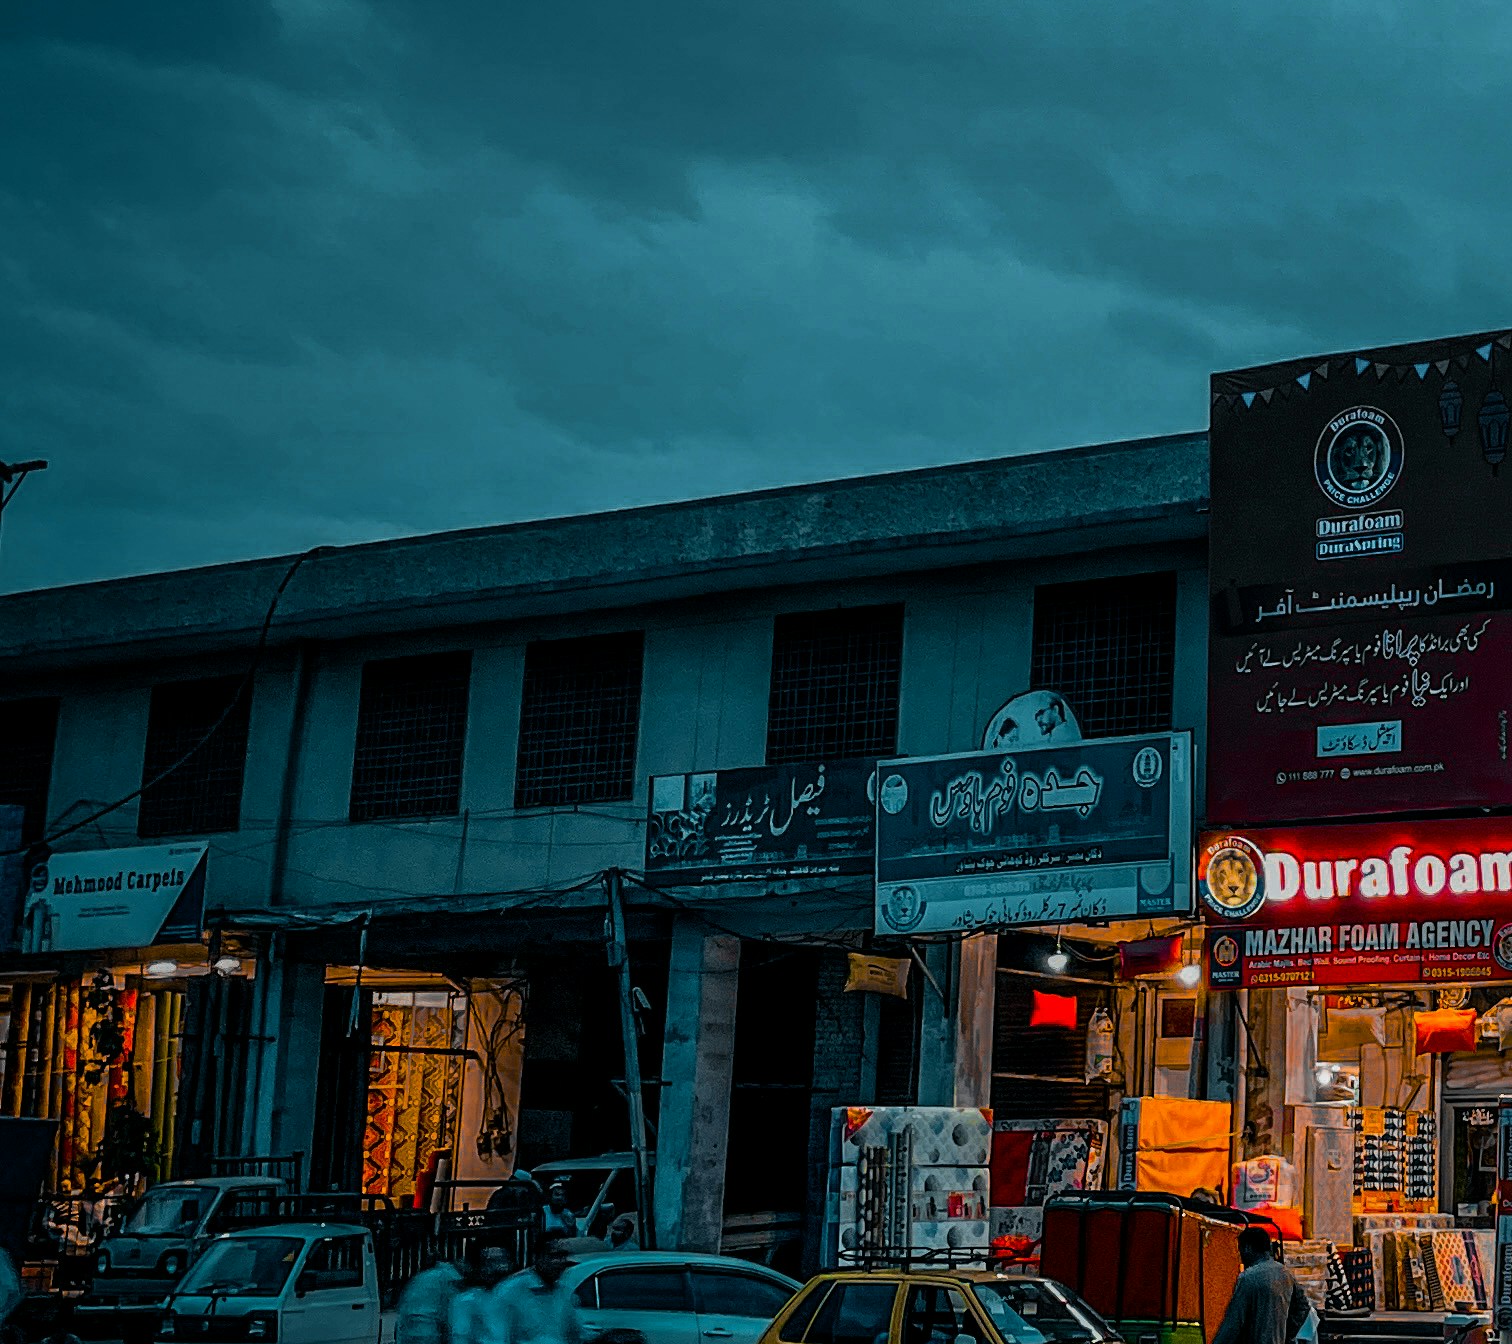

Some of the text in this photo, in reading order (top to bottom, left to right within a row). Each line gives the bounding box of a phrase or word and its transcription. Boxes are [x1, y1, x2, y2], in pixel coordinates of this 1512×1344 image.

[1330, 408, 1385, 432] Durafoam
[1323, 471, 1395, 504] PRICE CHALLENGE
[1319, 513, 1400, 535] Durafoam
[1319, 536, 1401, 555] DuraSpring
[1255, 589, 1294, 622] آفر
[1423, 578, 1494, 606] رمضان
[770, 764, 826, 836] فیصل
[983, 759, 1017, 834] فوم
[1020, 769, 1101, 817] جدہ
[53, 868, 184, 895] Mehmood Carpets
[1245, 919, 1495, 957] MAZHAR FOAM AGENCY
[1428, 953, 1450, 961] Home
[1453, 952, 1475, 960] Decor
[1211, 970, 1240, 979] MASTER
[1123, 1125, 1135, 1182] Duraoam
